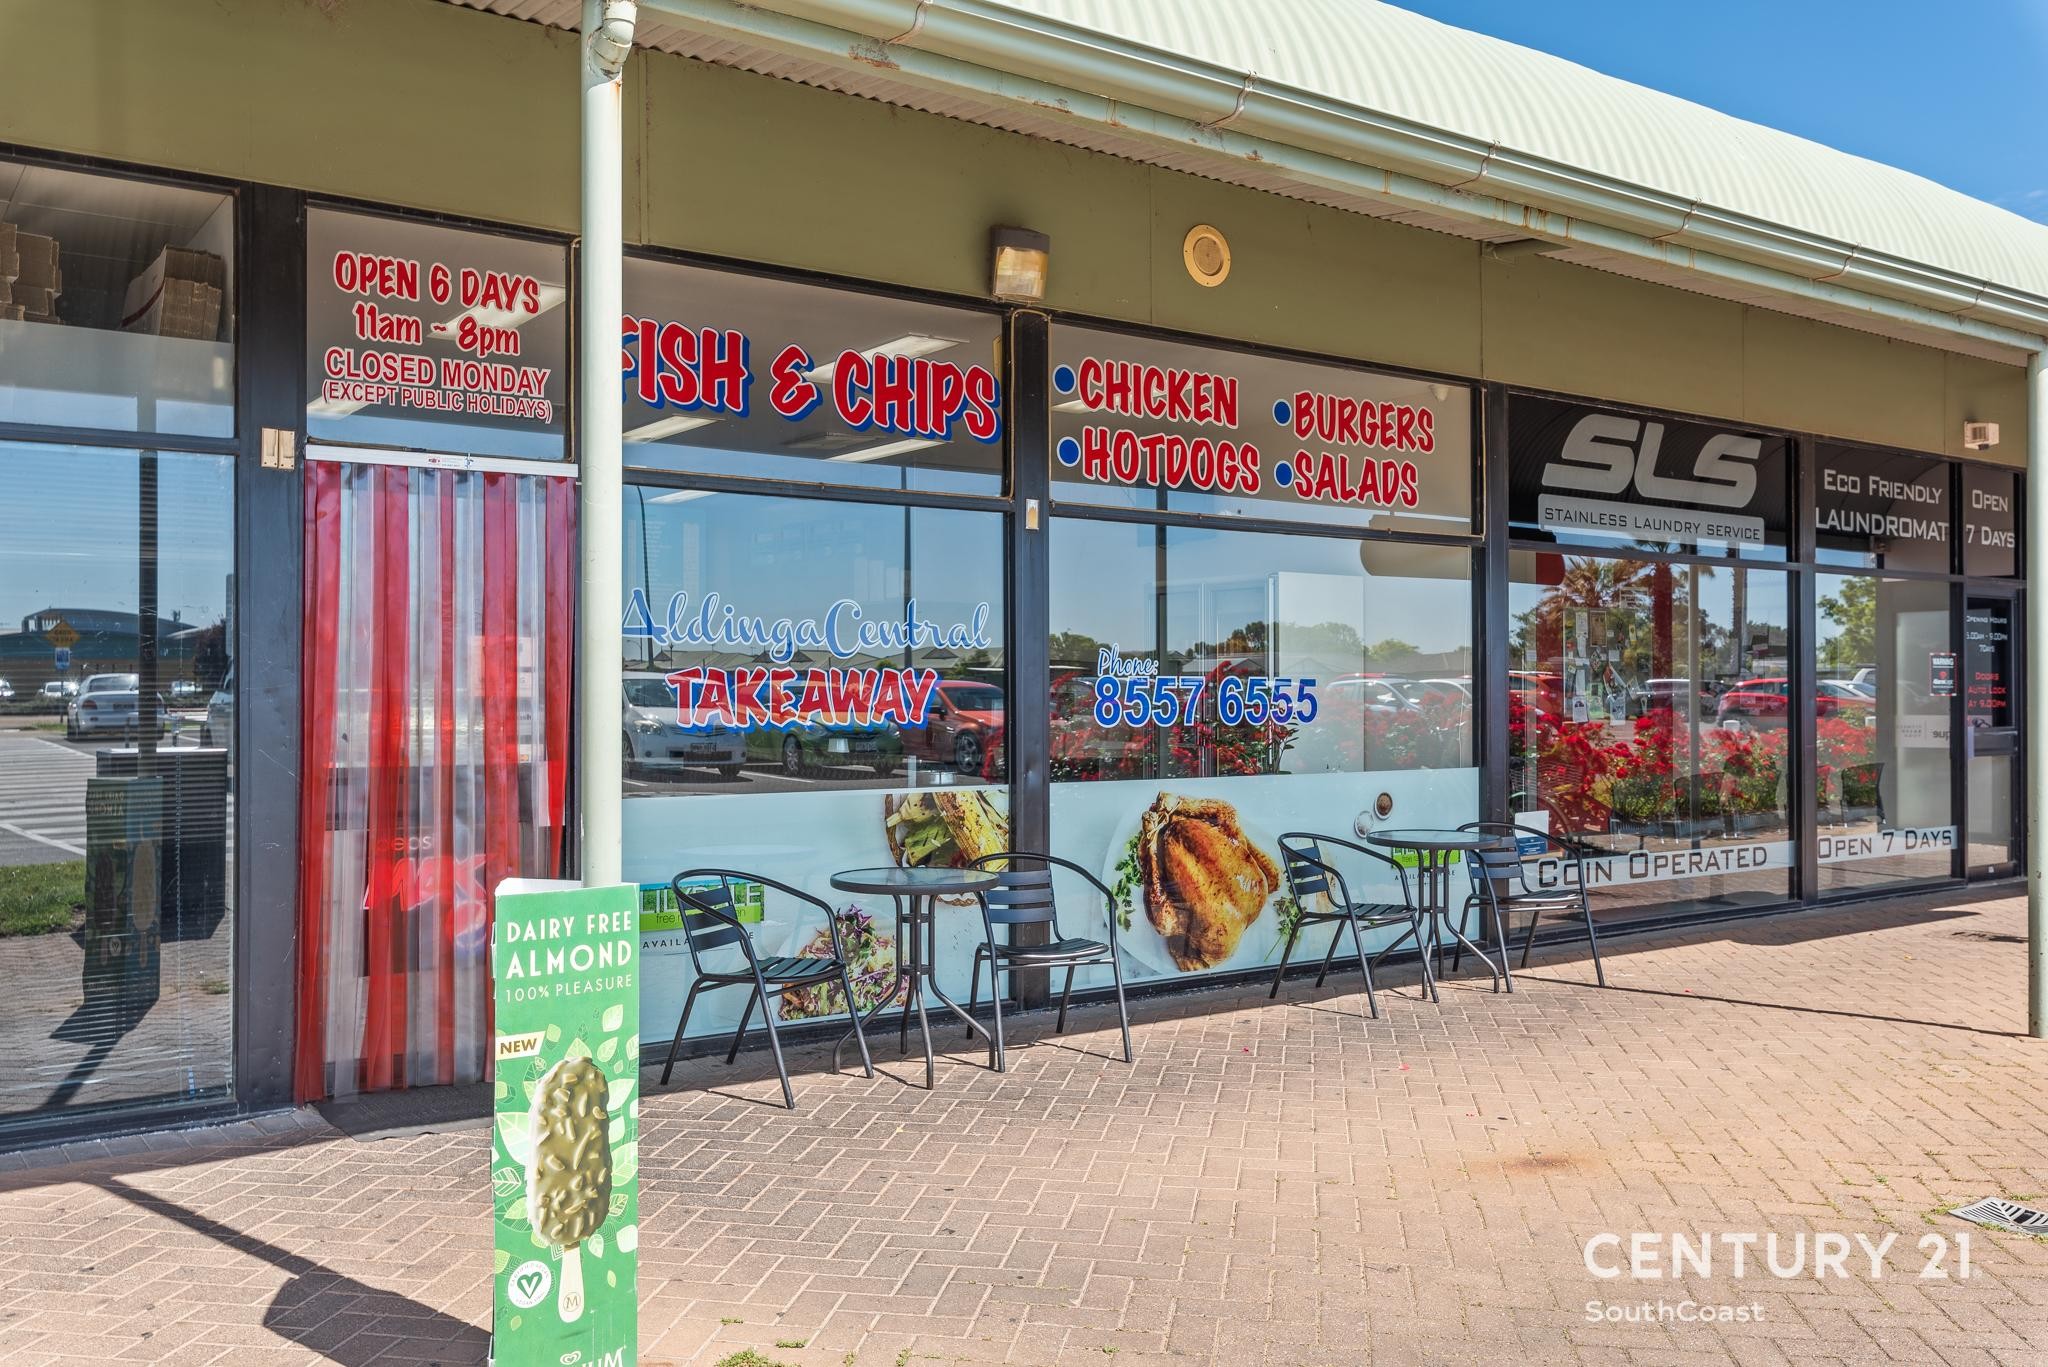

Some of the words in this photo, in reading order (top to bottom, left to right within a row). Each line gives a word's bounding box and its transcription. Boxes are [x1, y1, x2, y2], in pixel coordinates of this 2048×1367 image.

[333, 250, 420, 302] OPEN
[429, 263, 452, 304] 6
[460, 267, 541, 315] DAYS
[352, 302, 422, 346] 11am
[456, 315, 520, 358] 8pm
[324, 346, 435, 385] CLOSED
[440, 357, 551, 399] MONDAY
[770, 343, 823, 422] &
[832, 348, 1002, 445] CHIPS
[1077, 356, 1239, 430] CHICKEN
[321, 379, 398, 406] (EXCEPT
[401, 386, 463, 412] PUBLIC
[466, 394, 553, 425] HOLIDAYS)
[1293, 390, 1435, 455] BURGERS
[1081, 425, 1260, 495] HOTDOGS
[1293, 449, 1419, 509] SALADS
[1541, 413, 1762, 508] SLS
[1823, 468, 1861, 494] ECO
[1869, 475, 1943, 505] FRIENDLY
[1971, 489, 2009, 513] OPEN
[1544, 507, 1628, 528] STAINLESS
[1634, 516, 1701, 535] LAUNDRY
[1706, 523, 1761, 541] SERVICE
[1815, 506, 1949, 542] LAUNDROMAT
[1965, 524, 1975, 544] 7
[1981, 526, 2015, 549] DAYS
[622, 587, 825, 664] Aldinga
[824, 598, 992, 660] Central
[1097, 642, 1159, 677] Phone:
[664, 666, 941, 733] TAKEAWAY
[1094, 674, 1206, 729] 8557
[1218, 675, 1318, 727] 6555
[1818, 837, 1872, 859] OPEN
[1882, 831, 1895, 853] 7
[1905, 829, 1952, 850] DAYS
[1538, 859, 1612, 888] COIN
[1629, 846, 1768, 879] OPERATED
[507, 916, 575, 943] DAIRY
[586, 911, 632, 935] FREE
[656, 912, 676, 925] free
[505, 940, 632, 979] ALMOND
[505, 985, 549, 1003] 100%
[556, 974, 632, 997] PLEASURE
[500, 1037, 538, 1055] NEW
